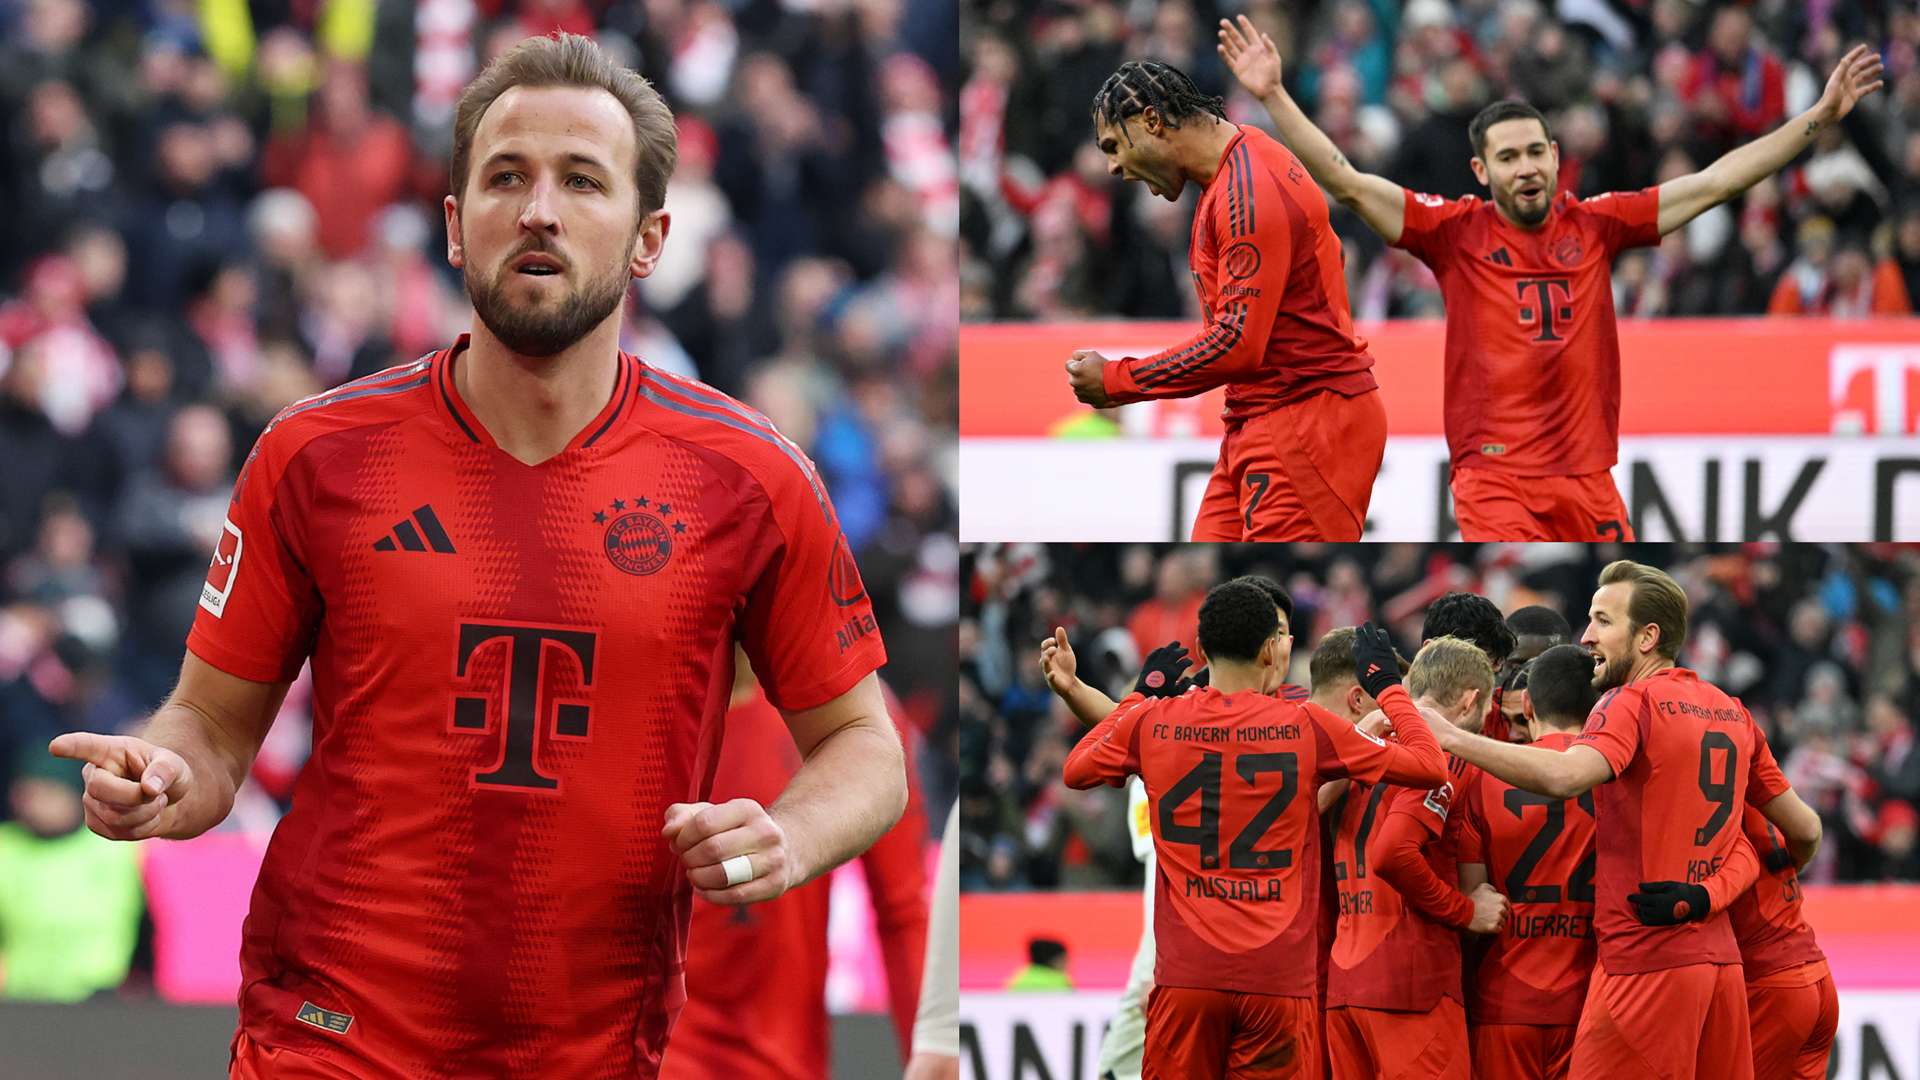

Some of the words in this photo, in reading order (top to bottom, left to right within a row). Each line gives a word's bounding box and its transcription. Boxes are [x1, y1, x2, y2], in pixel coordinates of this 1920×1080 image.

[1222, 284, 1262, 298] Allianz
[1245, 473, 1270, 530] 7
[453, 622, 598, 791] T
[1658, 701, 1677, 715] FC
[1152, 724, 1169, 740] FC
[1174, 725, 1230, 743] BAYERN
[1236, 724, 1301, 743] MÜNCHEN
[1694, 731, 1738, 847] 9
[1158, 752, 1299, 870] 42
[1185, 874, 1281, 902] MUSIALA
[1509, 914, 1596, 940] UERREI
